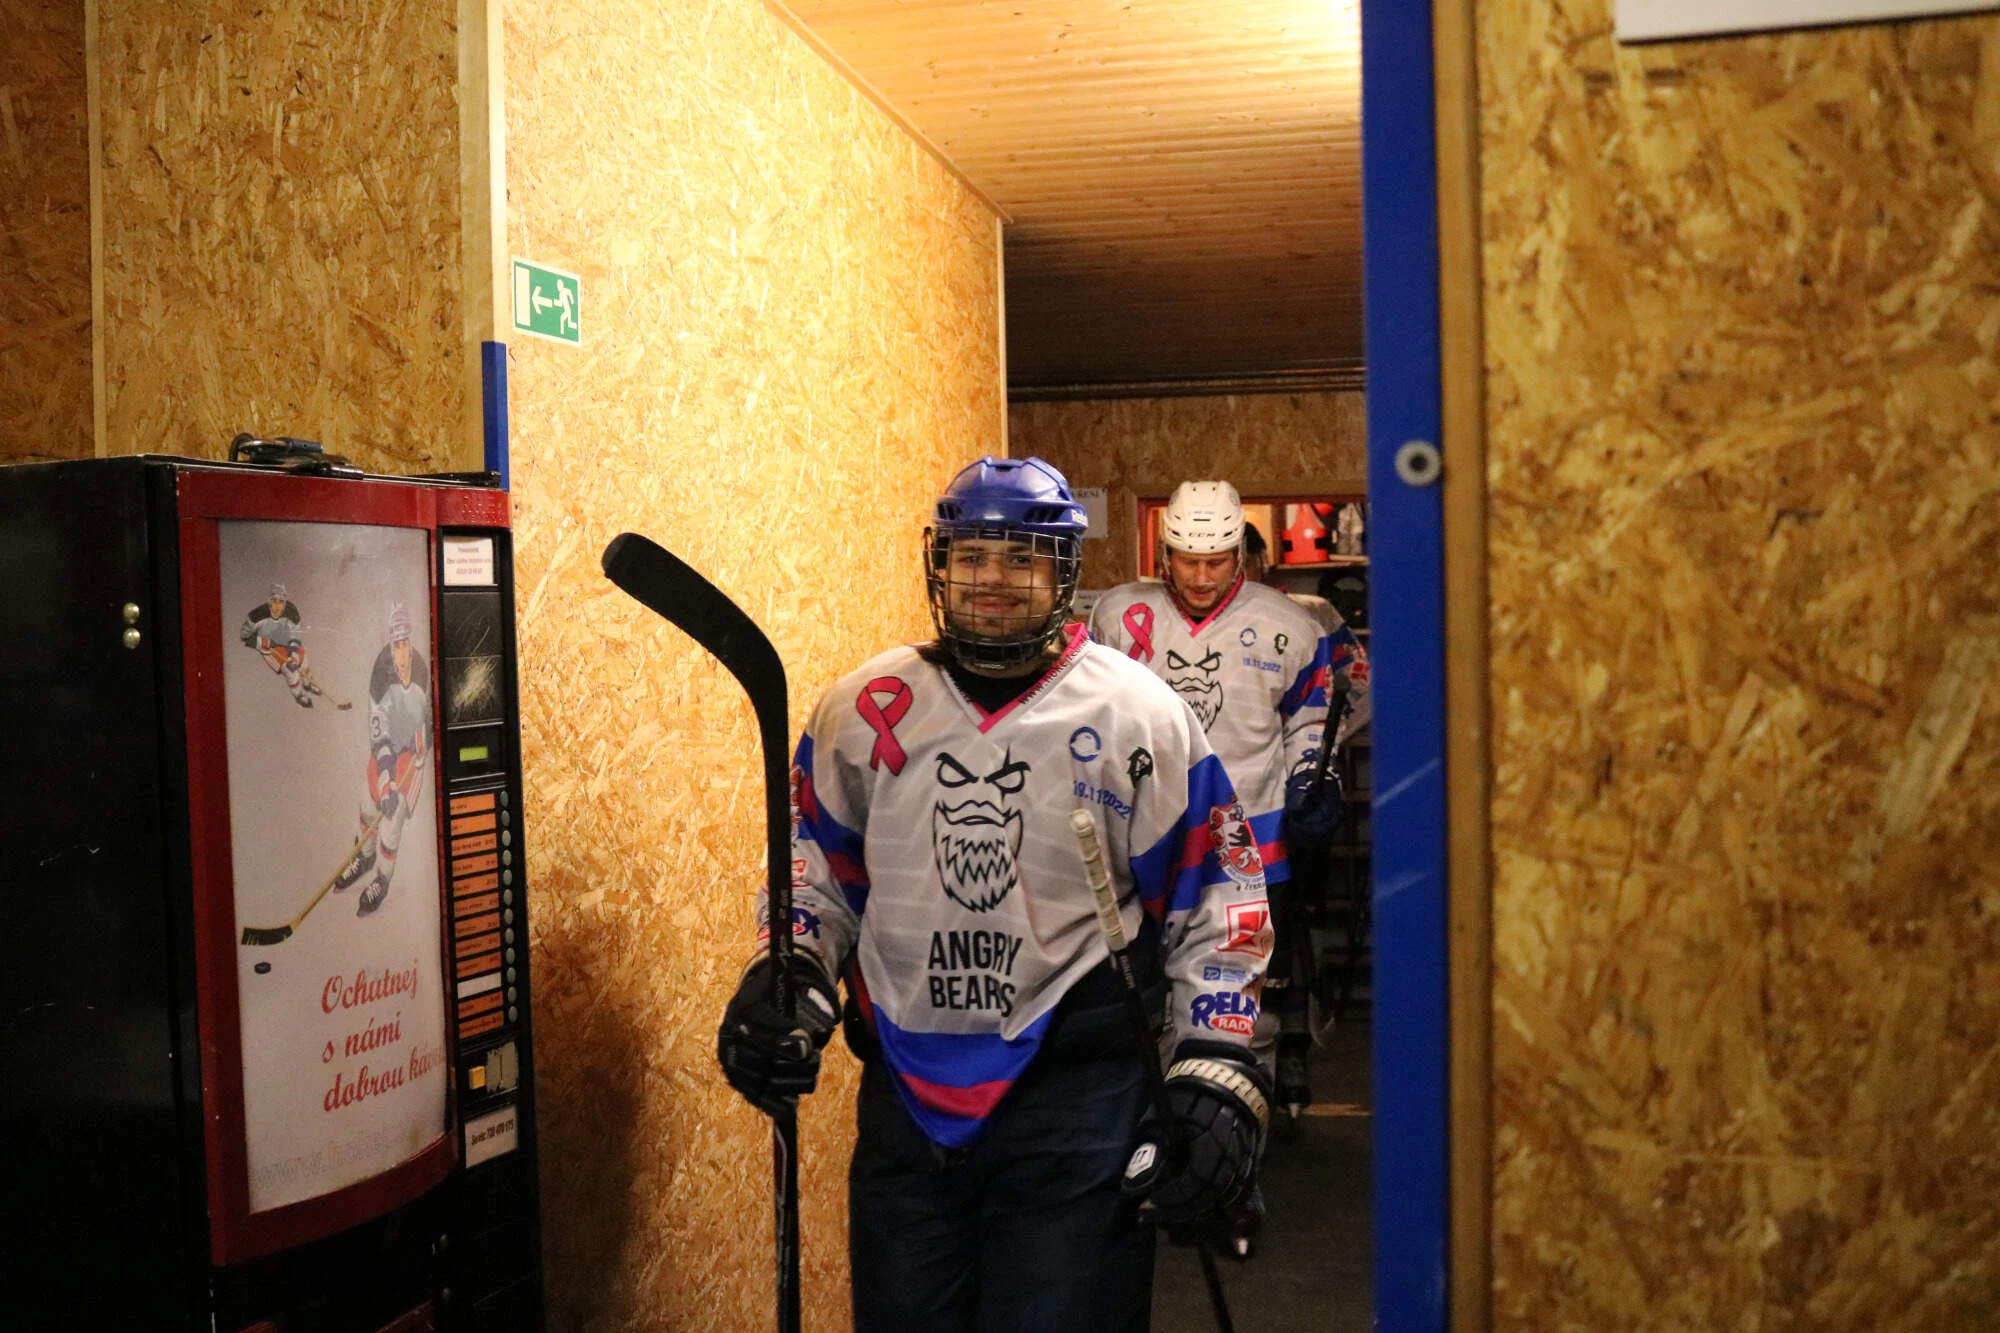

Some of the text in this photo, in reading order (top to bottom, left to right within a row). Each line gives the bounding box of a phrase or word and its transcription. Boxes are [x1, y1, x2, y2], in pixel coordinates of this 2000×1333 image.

[928, 930, 1024, 976] ANGRY
[321, 957, 417, 1014] Ochutnej
[928, 975, 1016, 1018] BEARS
[322, 1011, 402, 1064] s námi
[323, 1064, 404, 1112] dobrou
